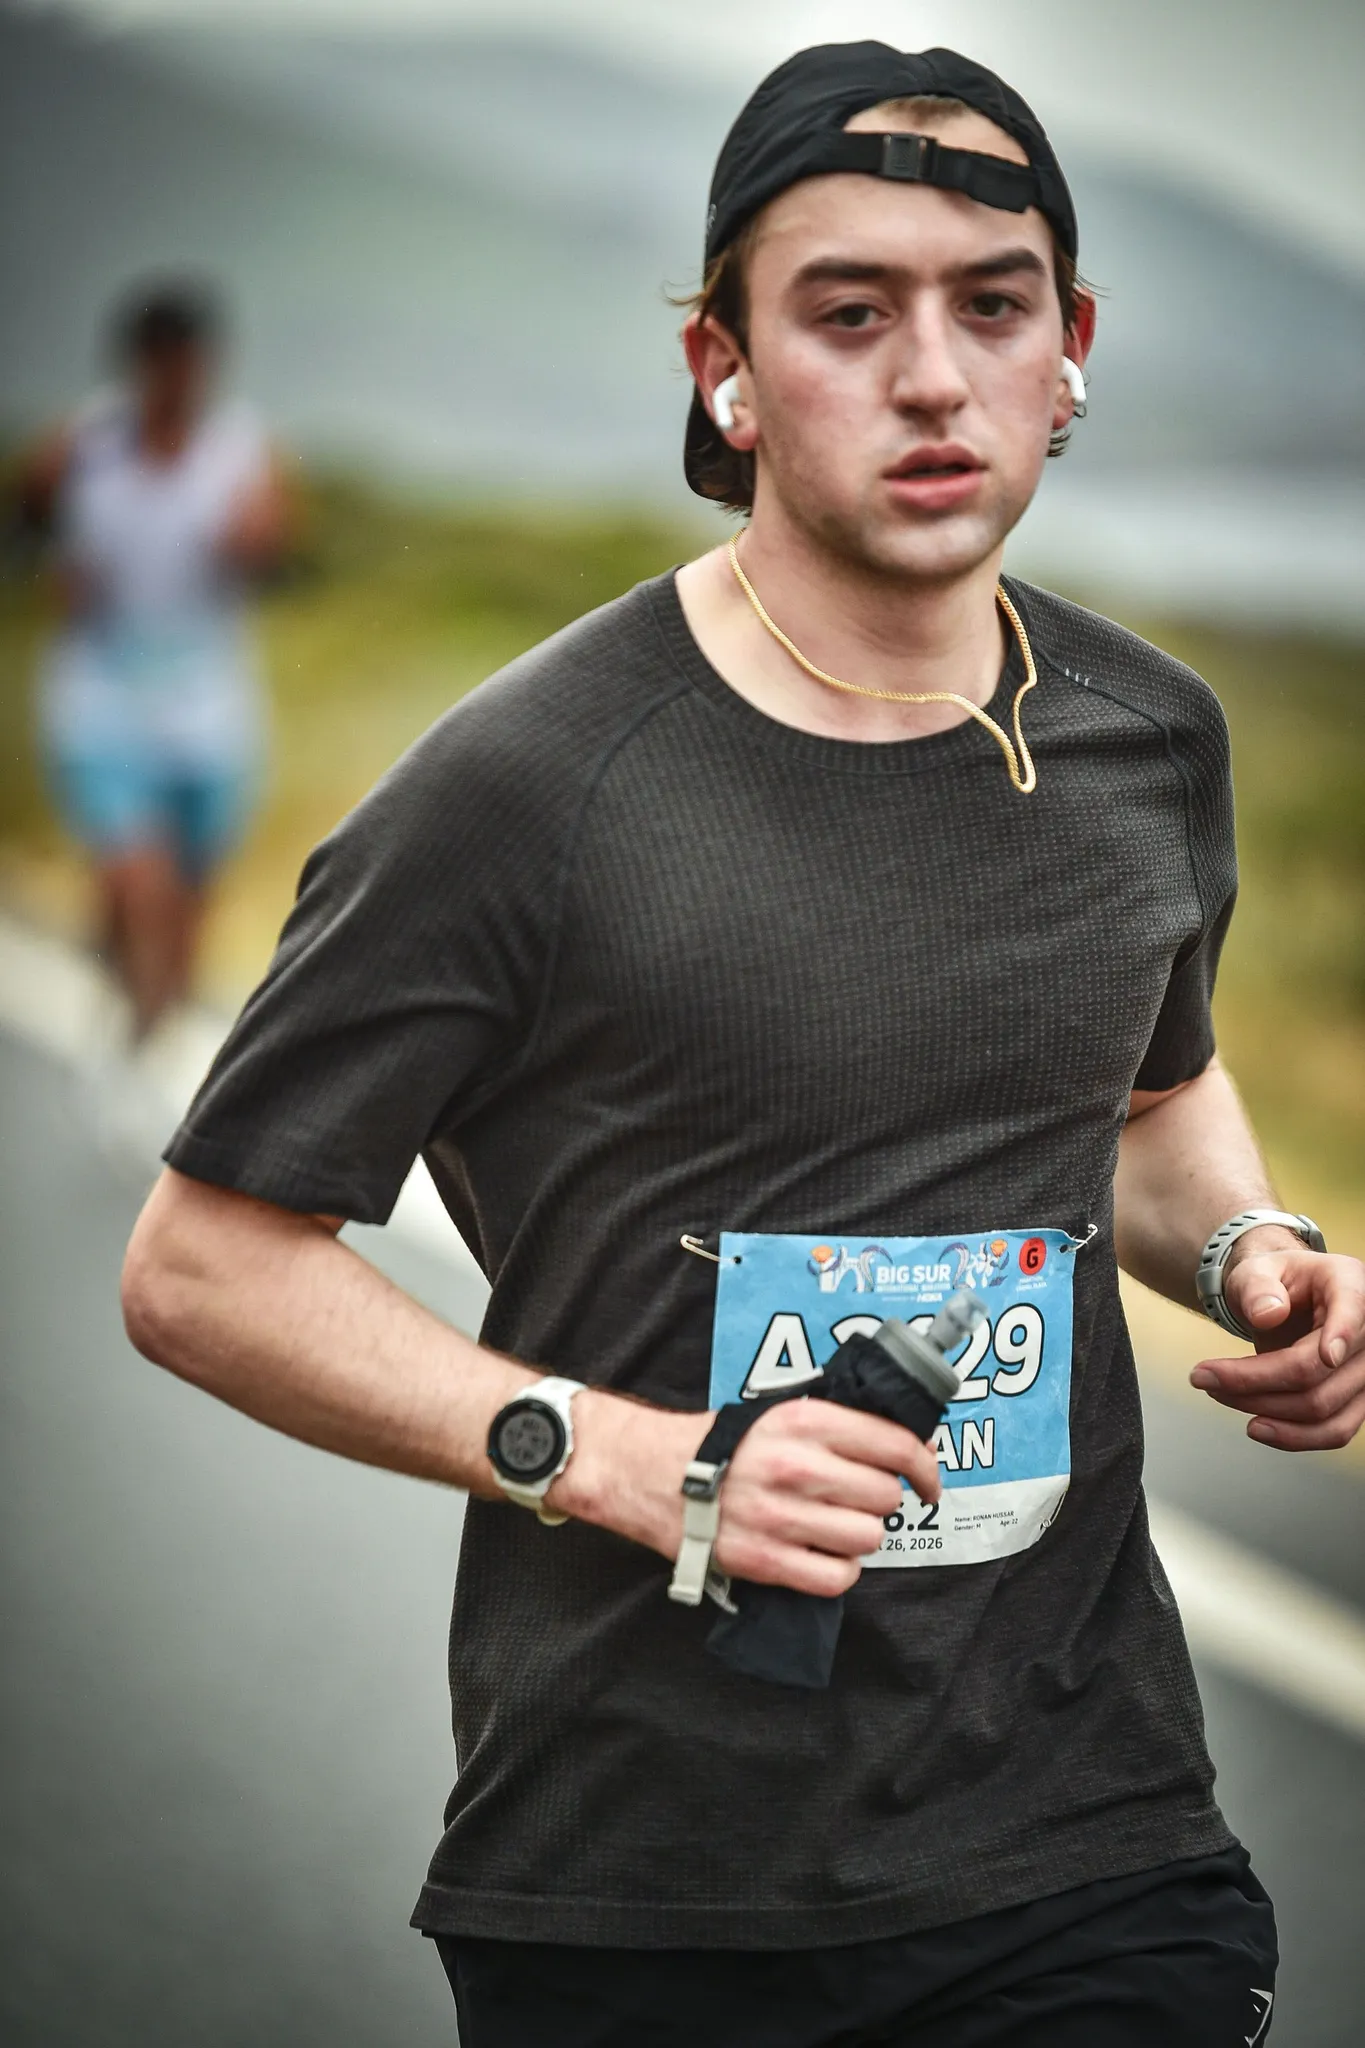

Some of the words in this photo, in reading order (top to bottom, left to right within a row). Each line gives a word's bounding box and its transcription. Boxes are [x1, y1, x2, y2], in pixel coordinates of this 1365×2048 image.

[1026, 1247, 1039, 1269] G
[877, 1265, 910, 1284] BIG
[912, 1264, 952, 1283] SUR
[883, 1500, 940, 1532] 6.2
[973, 1513, 992, 1521] RONAN
[993, 1510, 1014, 1519] HUSSAR
[886, 1538, 906, 1552] 26,
[910, 1537, 943, 1551] 2026
